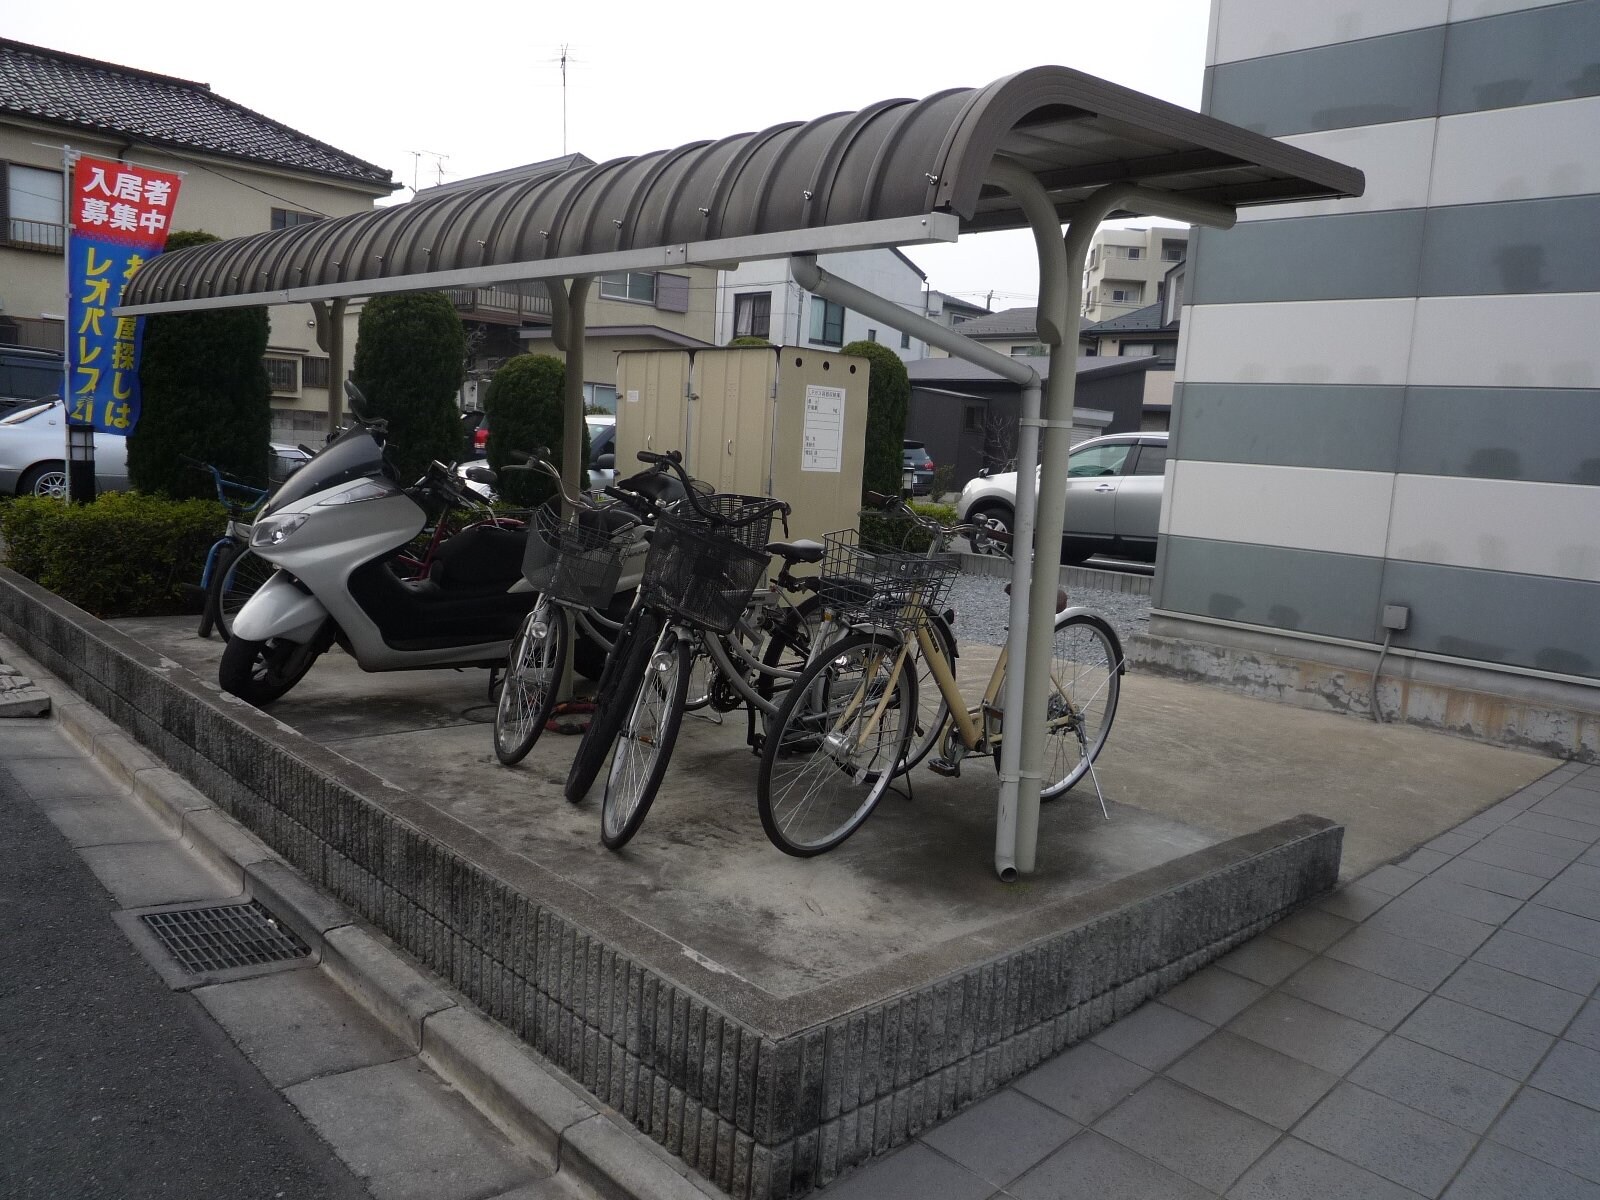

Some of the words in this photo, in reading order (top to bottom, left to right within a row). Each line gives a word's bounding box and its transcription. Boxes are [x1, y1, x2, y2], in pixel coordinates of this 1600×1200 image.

[83, 167, 171, 206] 入居者
[81, 197, 167, 235] 募集中
[104, 254, 144, 428] お屋探しは
